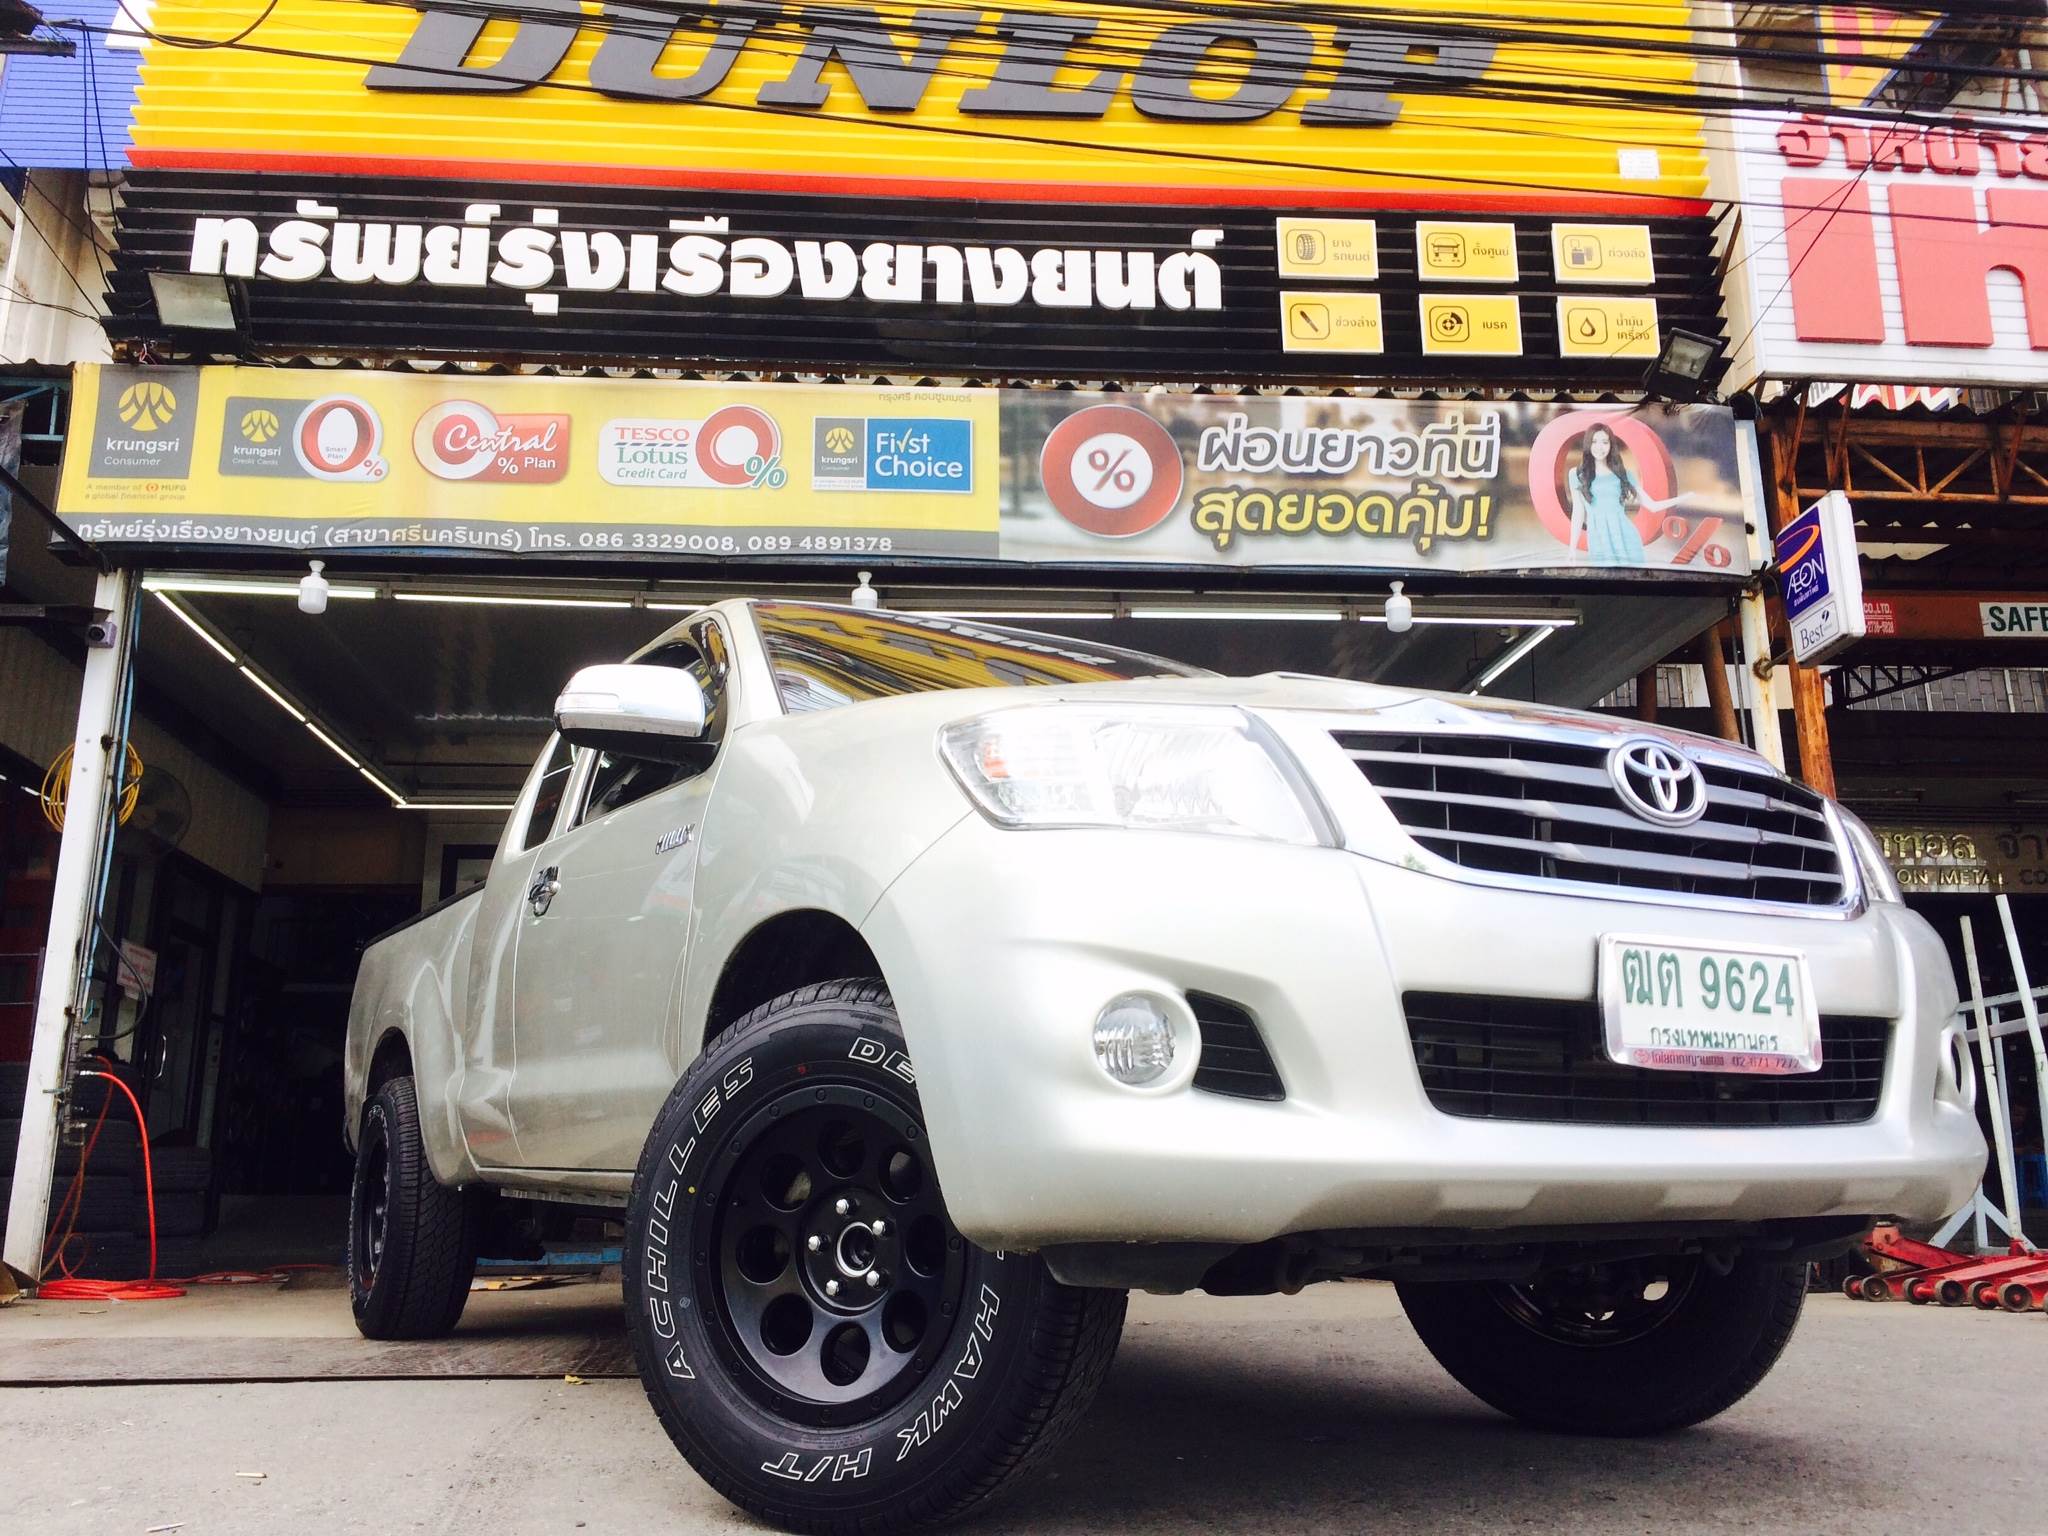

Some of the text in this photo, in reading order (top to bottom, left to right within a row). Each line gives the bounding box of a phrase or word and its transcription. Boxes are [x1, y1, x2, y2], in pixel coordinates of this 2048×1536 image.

[362, 0, 1498, 128] DUNLOP
[190, 199, 1225, 316] ทรัพย์รุ่งเรืองยางยนต์
[1332, 250, 1371, 262] รถยนต์
[1472, 242, 1510, 259] ตั้งศูนย์
[1335, 315, 1377, 328] ช่วงล่าง
[1482, 319, 1508, 330] เบรค
[1616, 312, 1644, 327] น้ำมัน
[1616, 328, 1651, 341] เครื่อง
[444, 422, 559, 453] Central
[614, 426, 690, 441] TESCO
[106, 437, 180, 454] krungsri
[233, 445, 281, 457] krungsri
[1201, 414, 1498, 475] ผ่อนยาวที่นี่
[103, 455, 162, 466] Consumer
[524, 456, 557, 469] Plan
[617, 446, 689, 465] Lotus
[821, 455, 858, 465] krungsri
[617, 467, 688, 480] Credit Card
[874, 455, 964, 479] Choice
[1195, 484, 1491, 551] สุดยอดคุ้ม!
[77, 517, 893, 553] ทรัพย์รุ่งเรืองยางยนต์ (สาขาศรีนครินทร์) โทร. 086 3329008, 089 4891378
[1800, 623, 1825, 650] Best
[1699, 955, 1795, 1017] 9624
[647, 1057, 755, 1380] ACHILLES
[761, 1283, 1000, 1482] HAWK H/T
